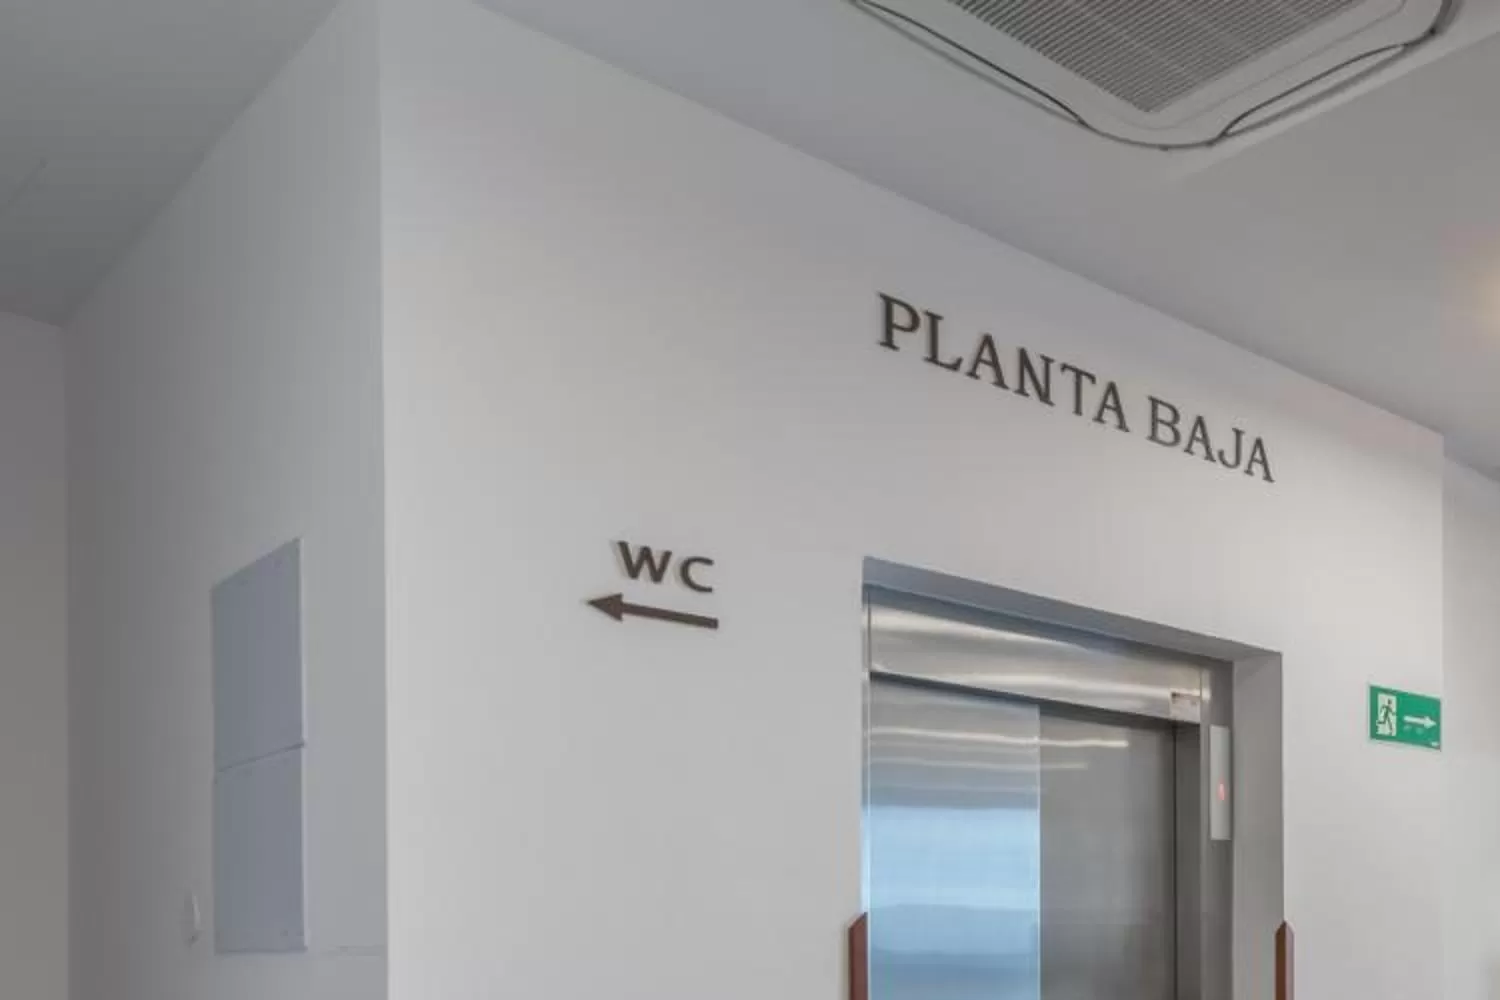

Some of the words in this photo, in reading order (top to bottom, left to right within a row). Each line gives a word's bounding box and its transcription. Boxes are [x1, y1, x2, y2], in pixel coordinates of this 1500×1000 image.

[877, 291, 1130, 433] PLANTA
[1146, 395, 1275, 483] BAJA
[616, 540, 715, 593] WC
